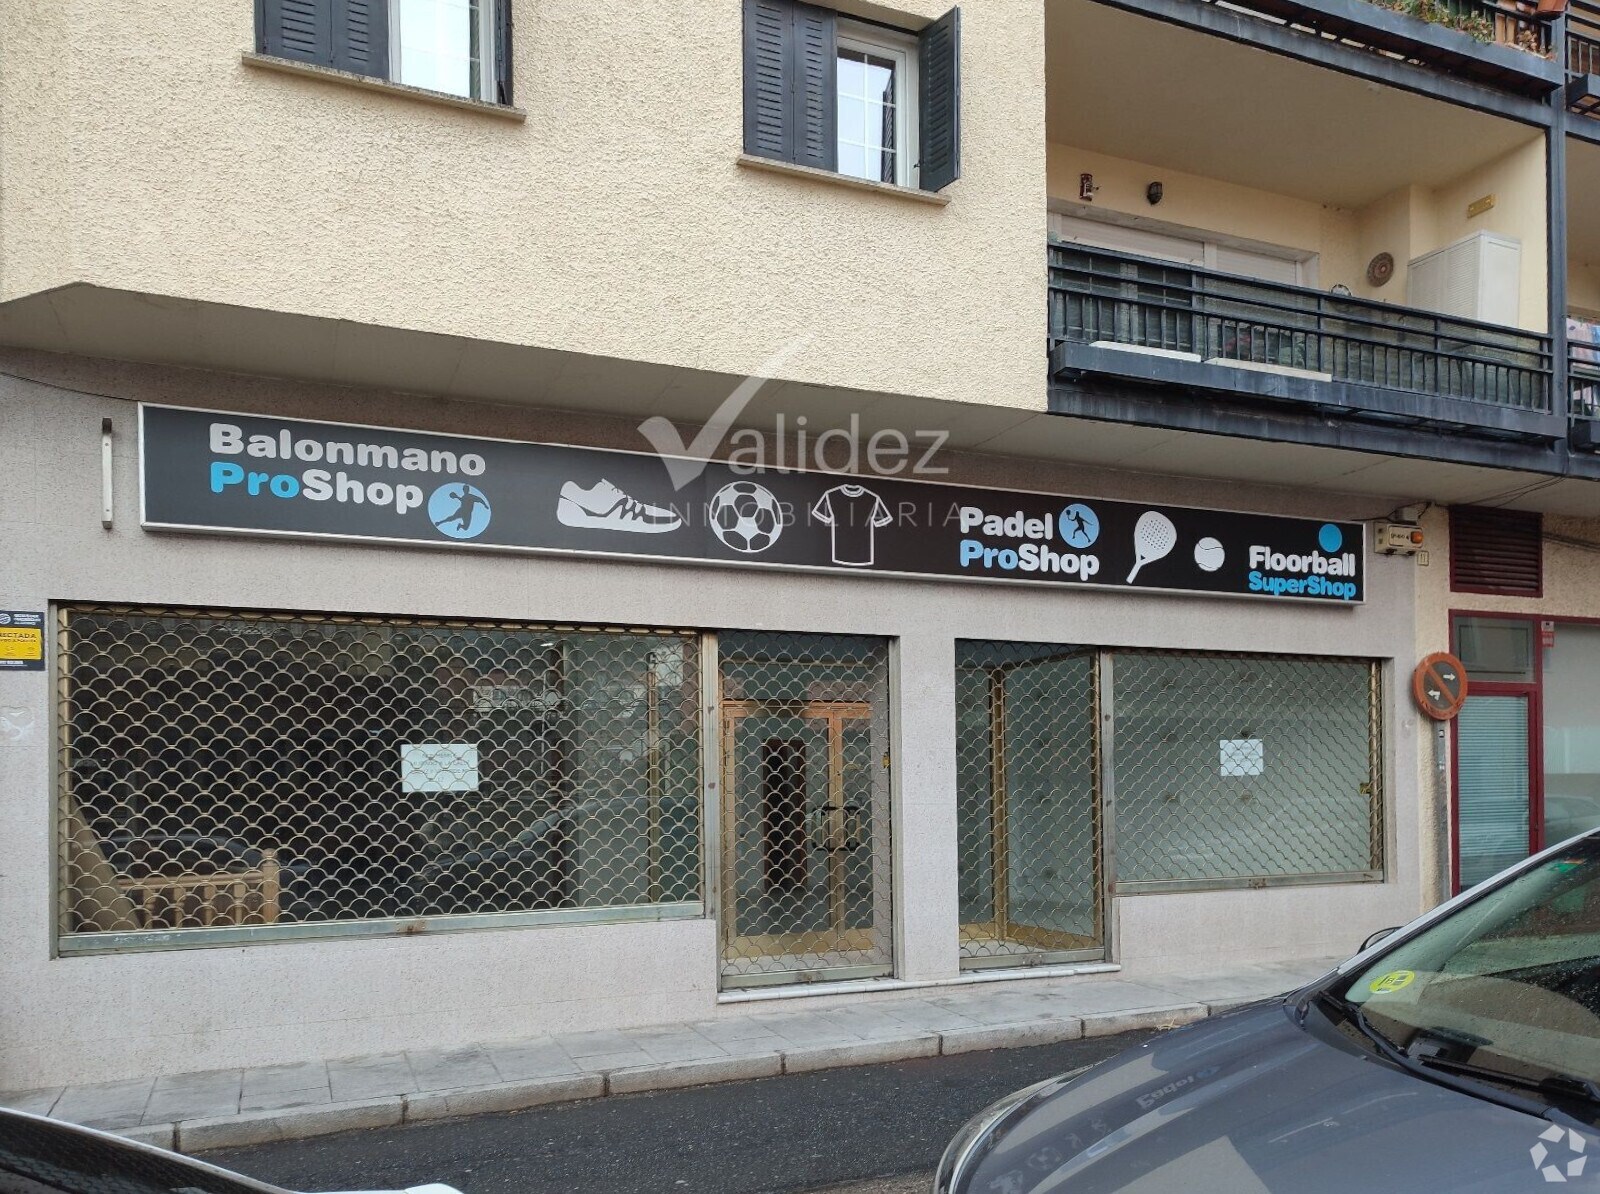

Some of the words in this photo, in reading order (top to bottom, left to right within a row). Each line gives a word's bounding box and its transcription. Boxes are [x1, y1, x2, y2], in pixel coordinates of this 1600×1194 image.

[209, 423, 486, 476] Balonmano
[210, 462, 424, 514] ProShop
[960, 506, 1053, 540] Padel
[960, 539, 1100, 581] ProShop
[1249, 545, 1356, 577] Floorball
[1249, 571, 1356, 600] SuperShop
